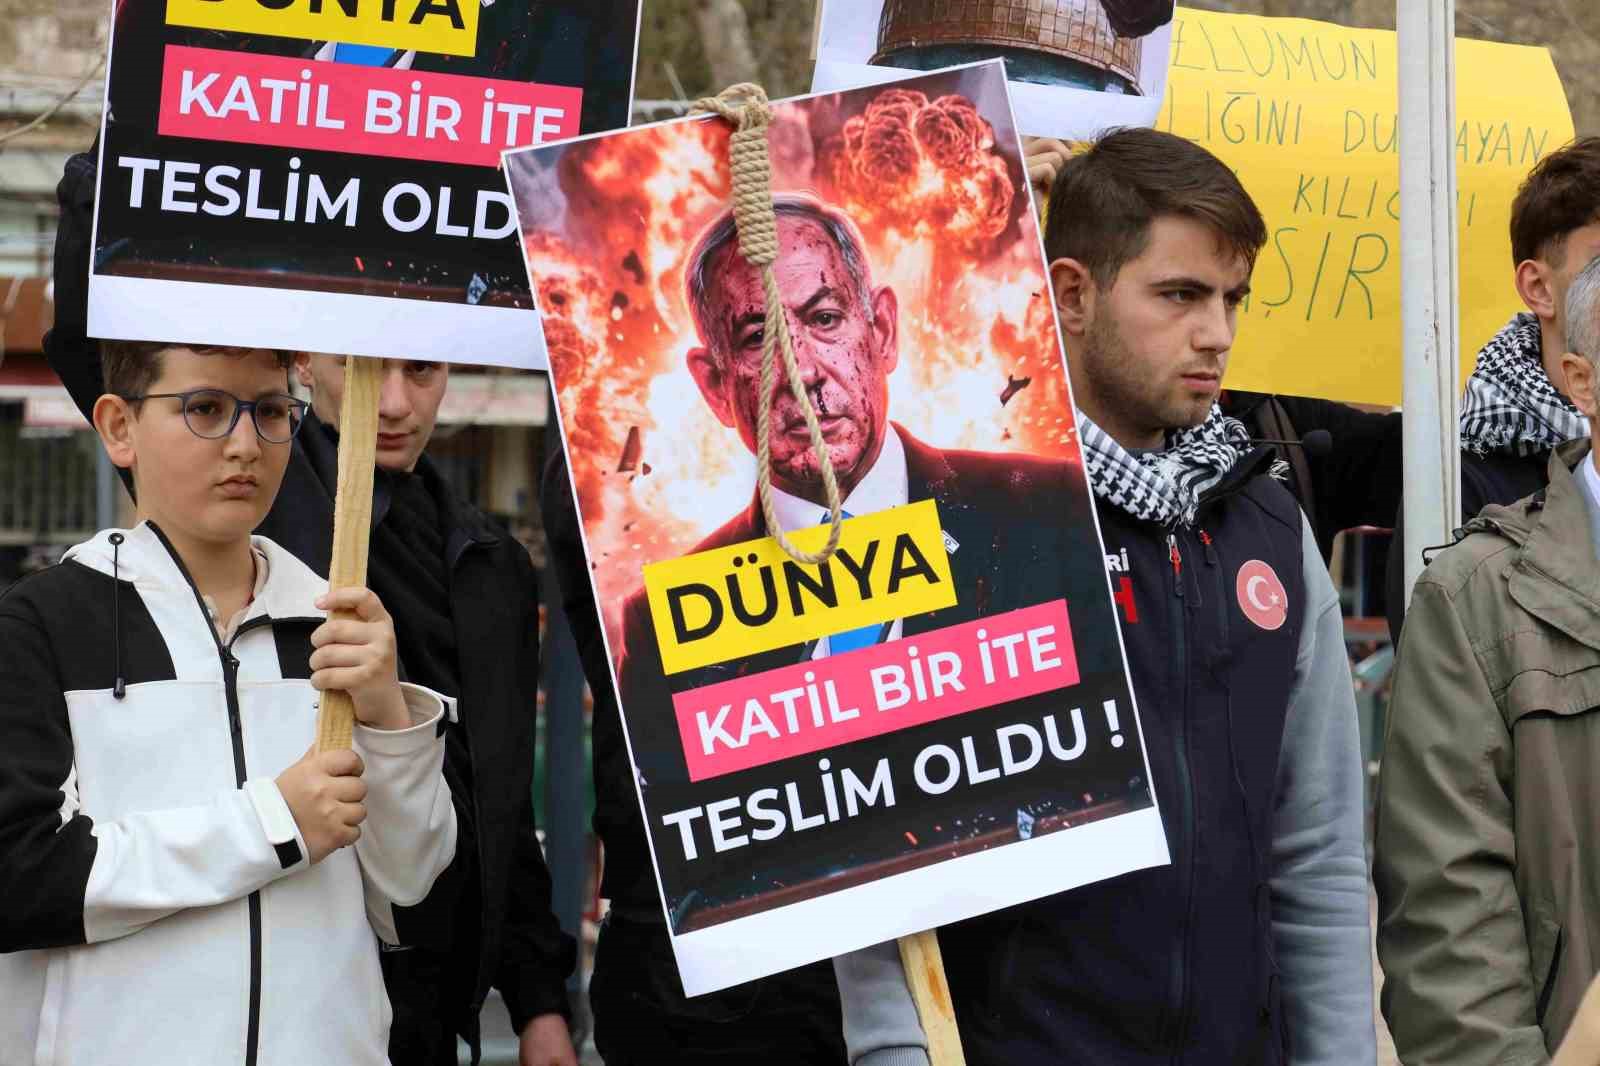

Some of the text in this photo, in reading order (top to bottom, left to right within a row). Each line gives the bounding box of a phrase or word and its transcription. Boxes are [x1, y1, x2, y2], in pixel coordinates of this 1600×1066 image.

[178, 69, 565, 145] KATİL BİR İTE
[1343, 109, 1549, 167] DUAYAN
[118, 156, 361, 228] TESLİM
[1243, 226, 1389, 321] ŞIR
[666, 532, 941, 645] DÜNYA
[695, 625, 1062, 756] KATİL BİR İTE
[661, 757, 896, 862] TESLİM
[913, 707, 1088, 796] OLDU
